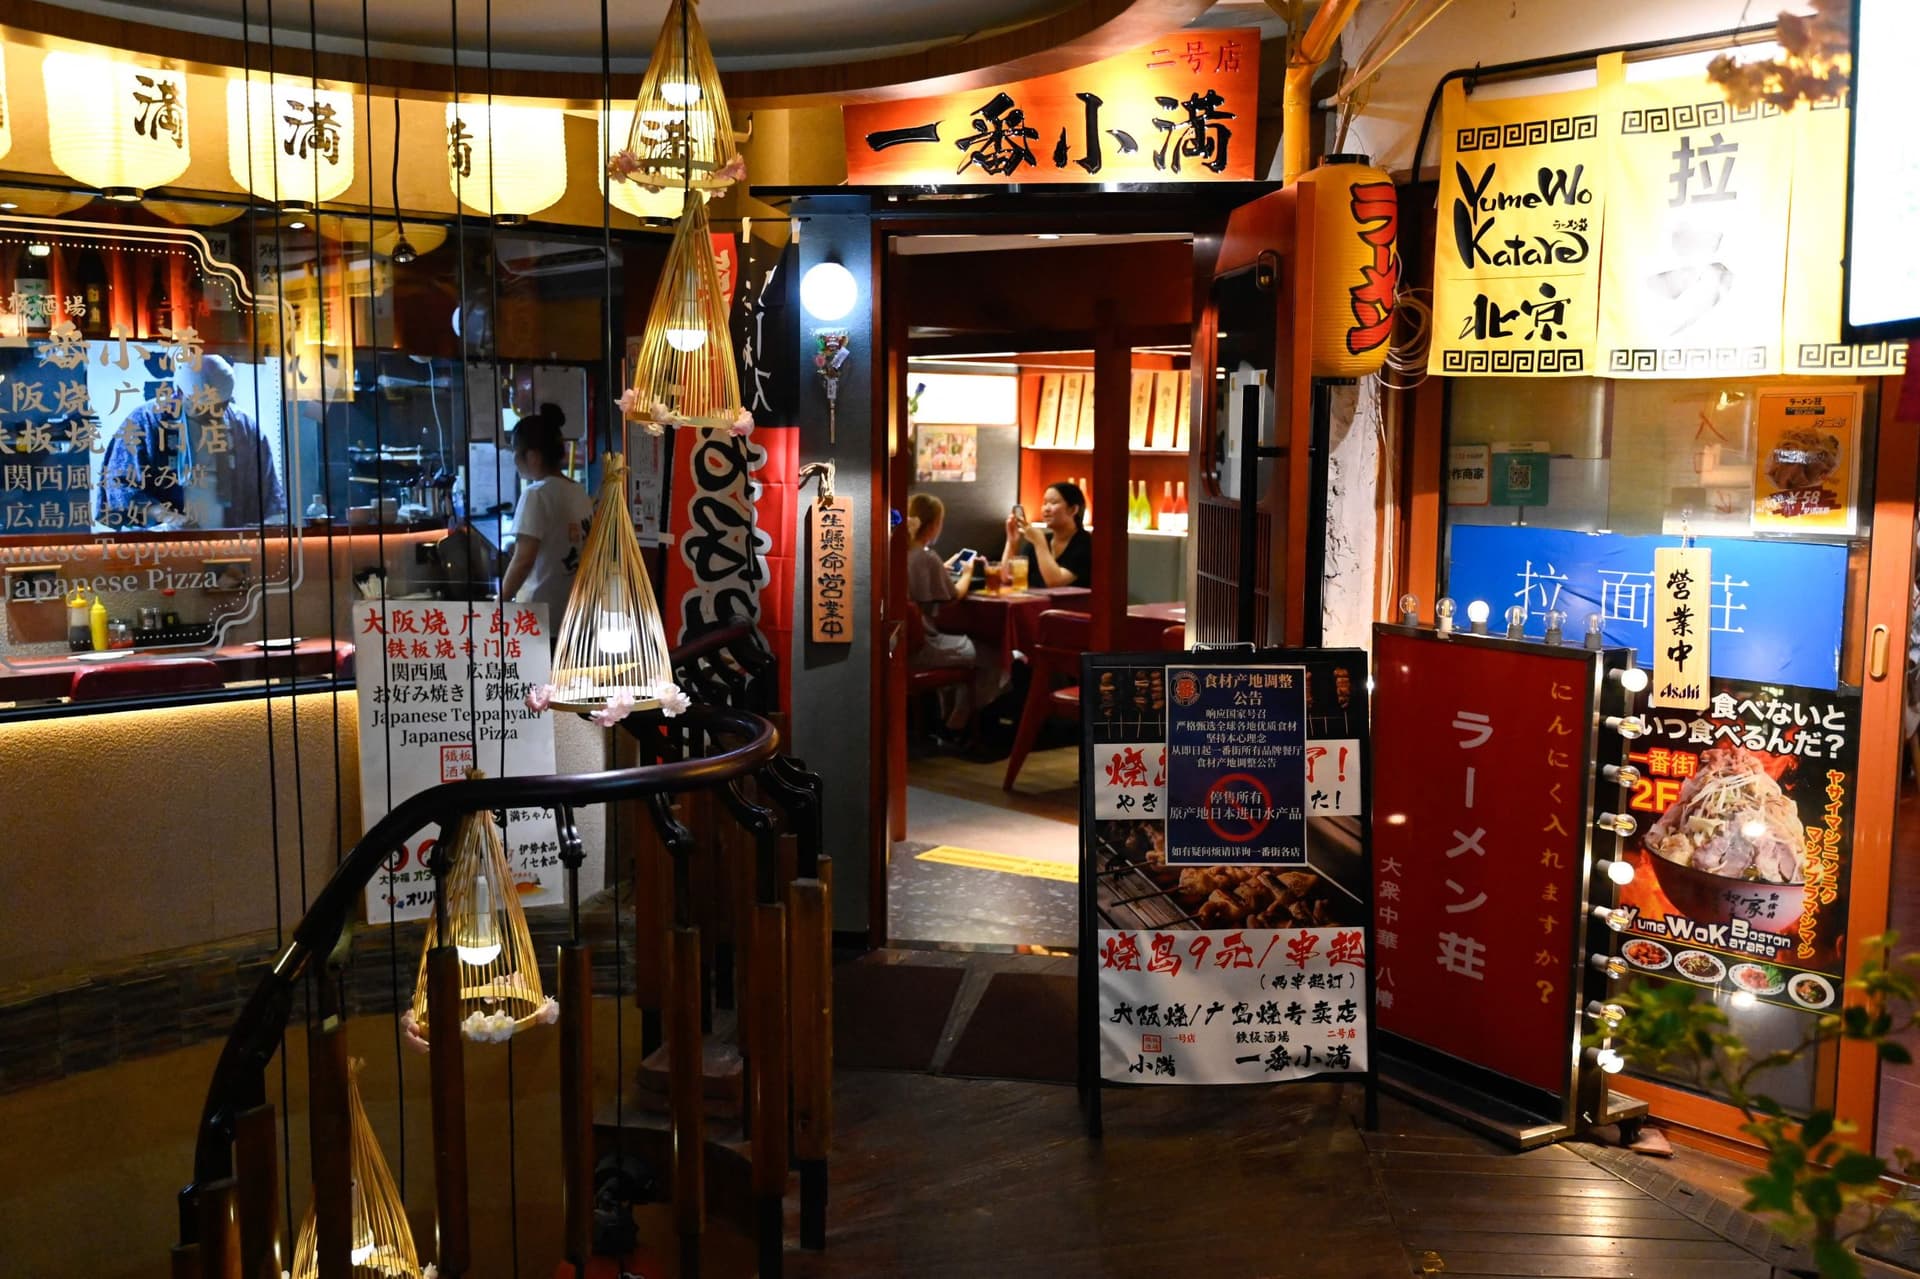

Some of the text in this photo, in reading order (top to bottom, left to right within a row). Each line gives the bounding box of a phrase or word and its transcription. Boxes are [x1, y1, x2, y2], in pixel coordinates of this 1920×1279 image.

[1147, 40, 1243, 74] 二号店
[1346, 182, 1398, 355] ラーメン
[1459, 282, 1571, 342] 北京
[3, 567, 218, 603] Japanese Pizza
[1205, 674, 1293, 689] 食材产地调整
[1233, 691, 1262, 706] 公告
[1660, 683, 1701, 700] Asahi
[371, 710, 447, 728] Japanese
[1205, 708, 1267, 719] 响应国家号召
[1711, 692, 1846, 733] 食べないと
[1176, 720, 1298, 732] 严格甄选全球各地优质食材
[400, 724, 518, 748] Japanese Pizza
[1206, 733, 1267, 744] 坚持本心理念
[1171, 745, 1301, 756] 从即日起一番街所有品牌餐厅
[1197, 757, 1277, 769] 食材产地调整公告
[1628, 751, 1697, 778] 一番街
[1210, 791, 1263, 805] 停售所有
[1631, 780, 1680, 812] 2F
[1169, 806, 1302, 821] 原产地日本进口水产品
[1171, 846, 1301, 857] 如有疑问烦请详询一番街各店
